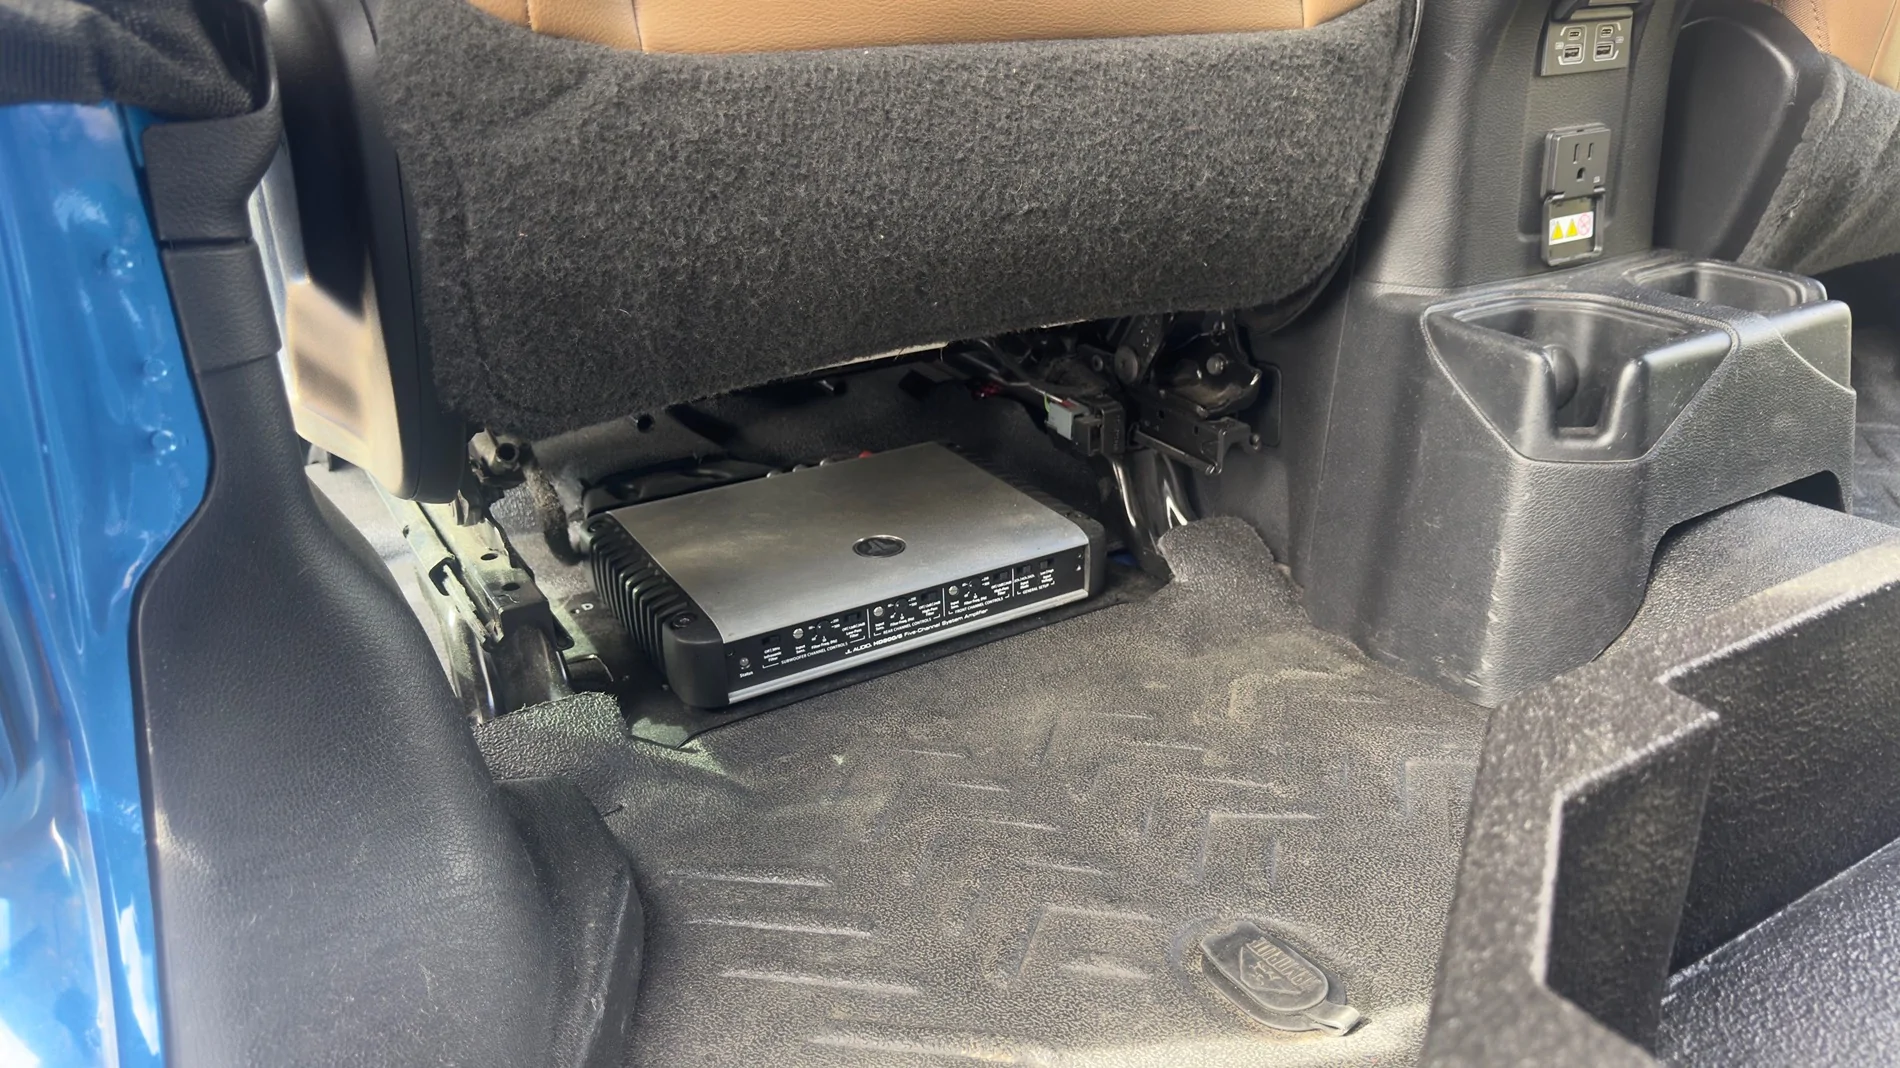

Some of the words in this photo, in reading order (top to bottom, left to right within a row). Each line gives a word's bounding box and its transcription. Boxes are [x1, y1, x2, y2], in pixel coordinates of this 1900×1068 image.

[904, 622, 940, 636] Five-Channel
[941, 616, 963, 625] System
[964, 608, 988, 619] Amplifier
[781, 653, 806, 664] SUBWOOFER
[807, 648, 826, 656] CHANNEL
[826, 641, 848, 651] CONTROLS
